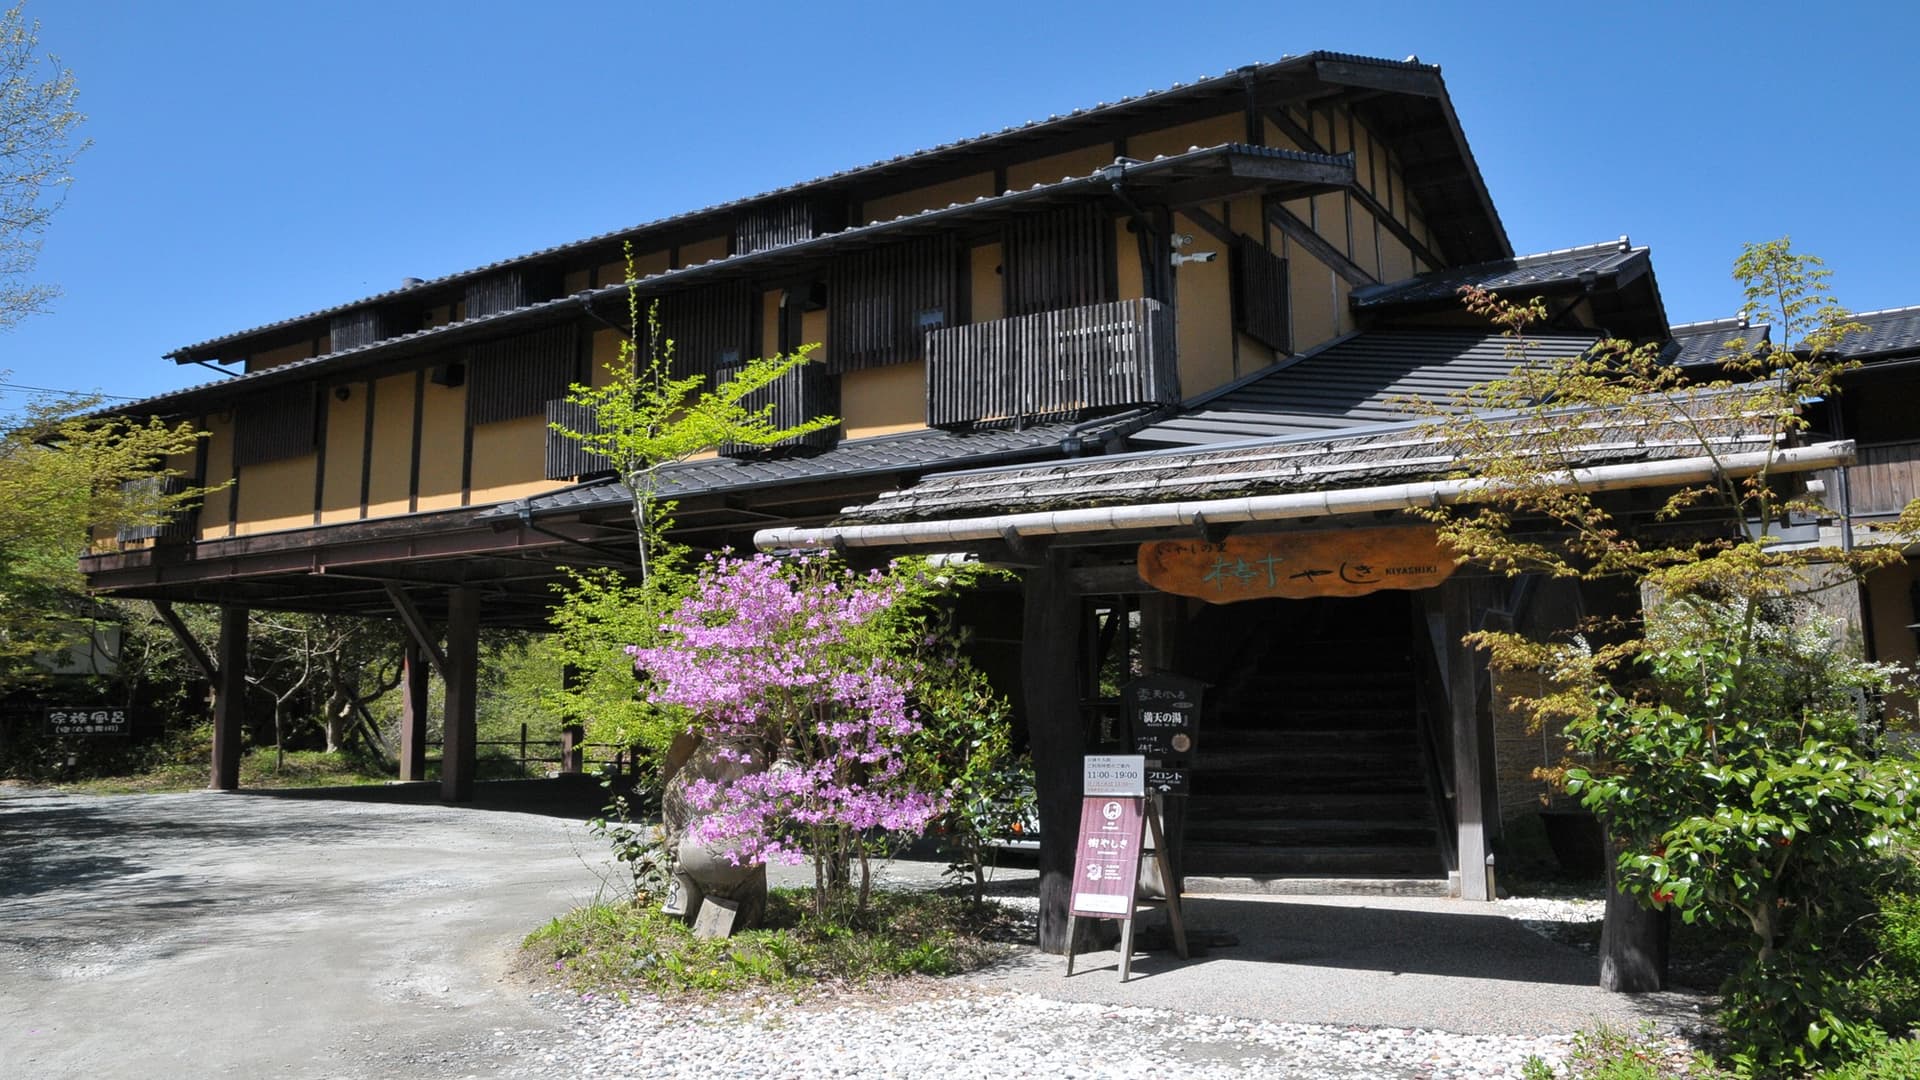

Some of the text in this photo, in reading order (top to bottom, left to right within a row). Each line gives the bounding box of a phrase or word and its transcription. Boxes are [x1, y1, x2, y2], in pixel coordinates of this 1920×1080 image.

[1385, 564, 1438, 576] KIYASHIKI
[50, 711, 125, 724] 家族風呂
[1148, 771, 1183, 780] フロント
[1087, 838, 1128, 849] 樹やしき
